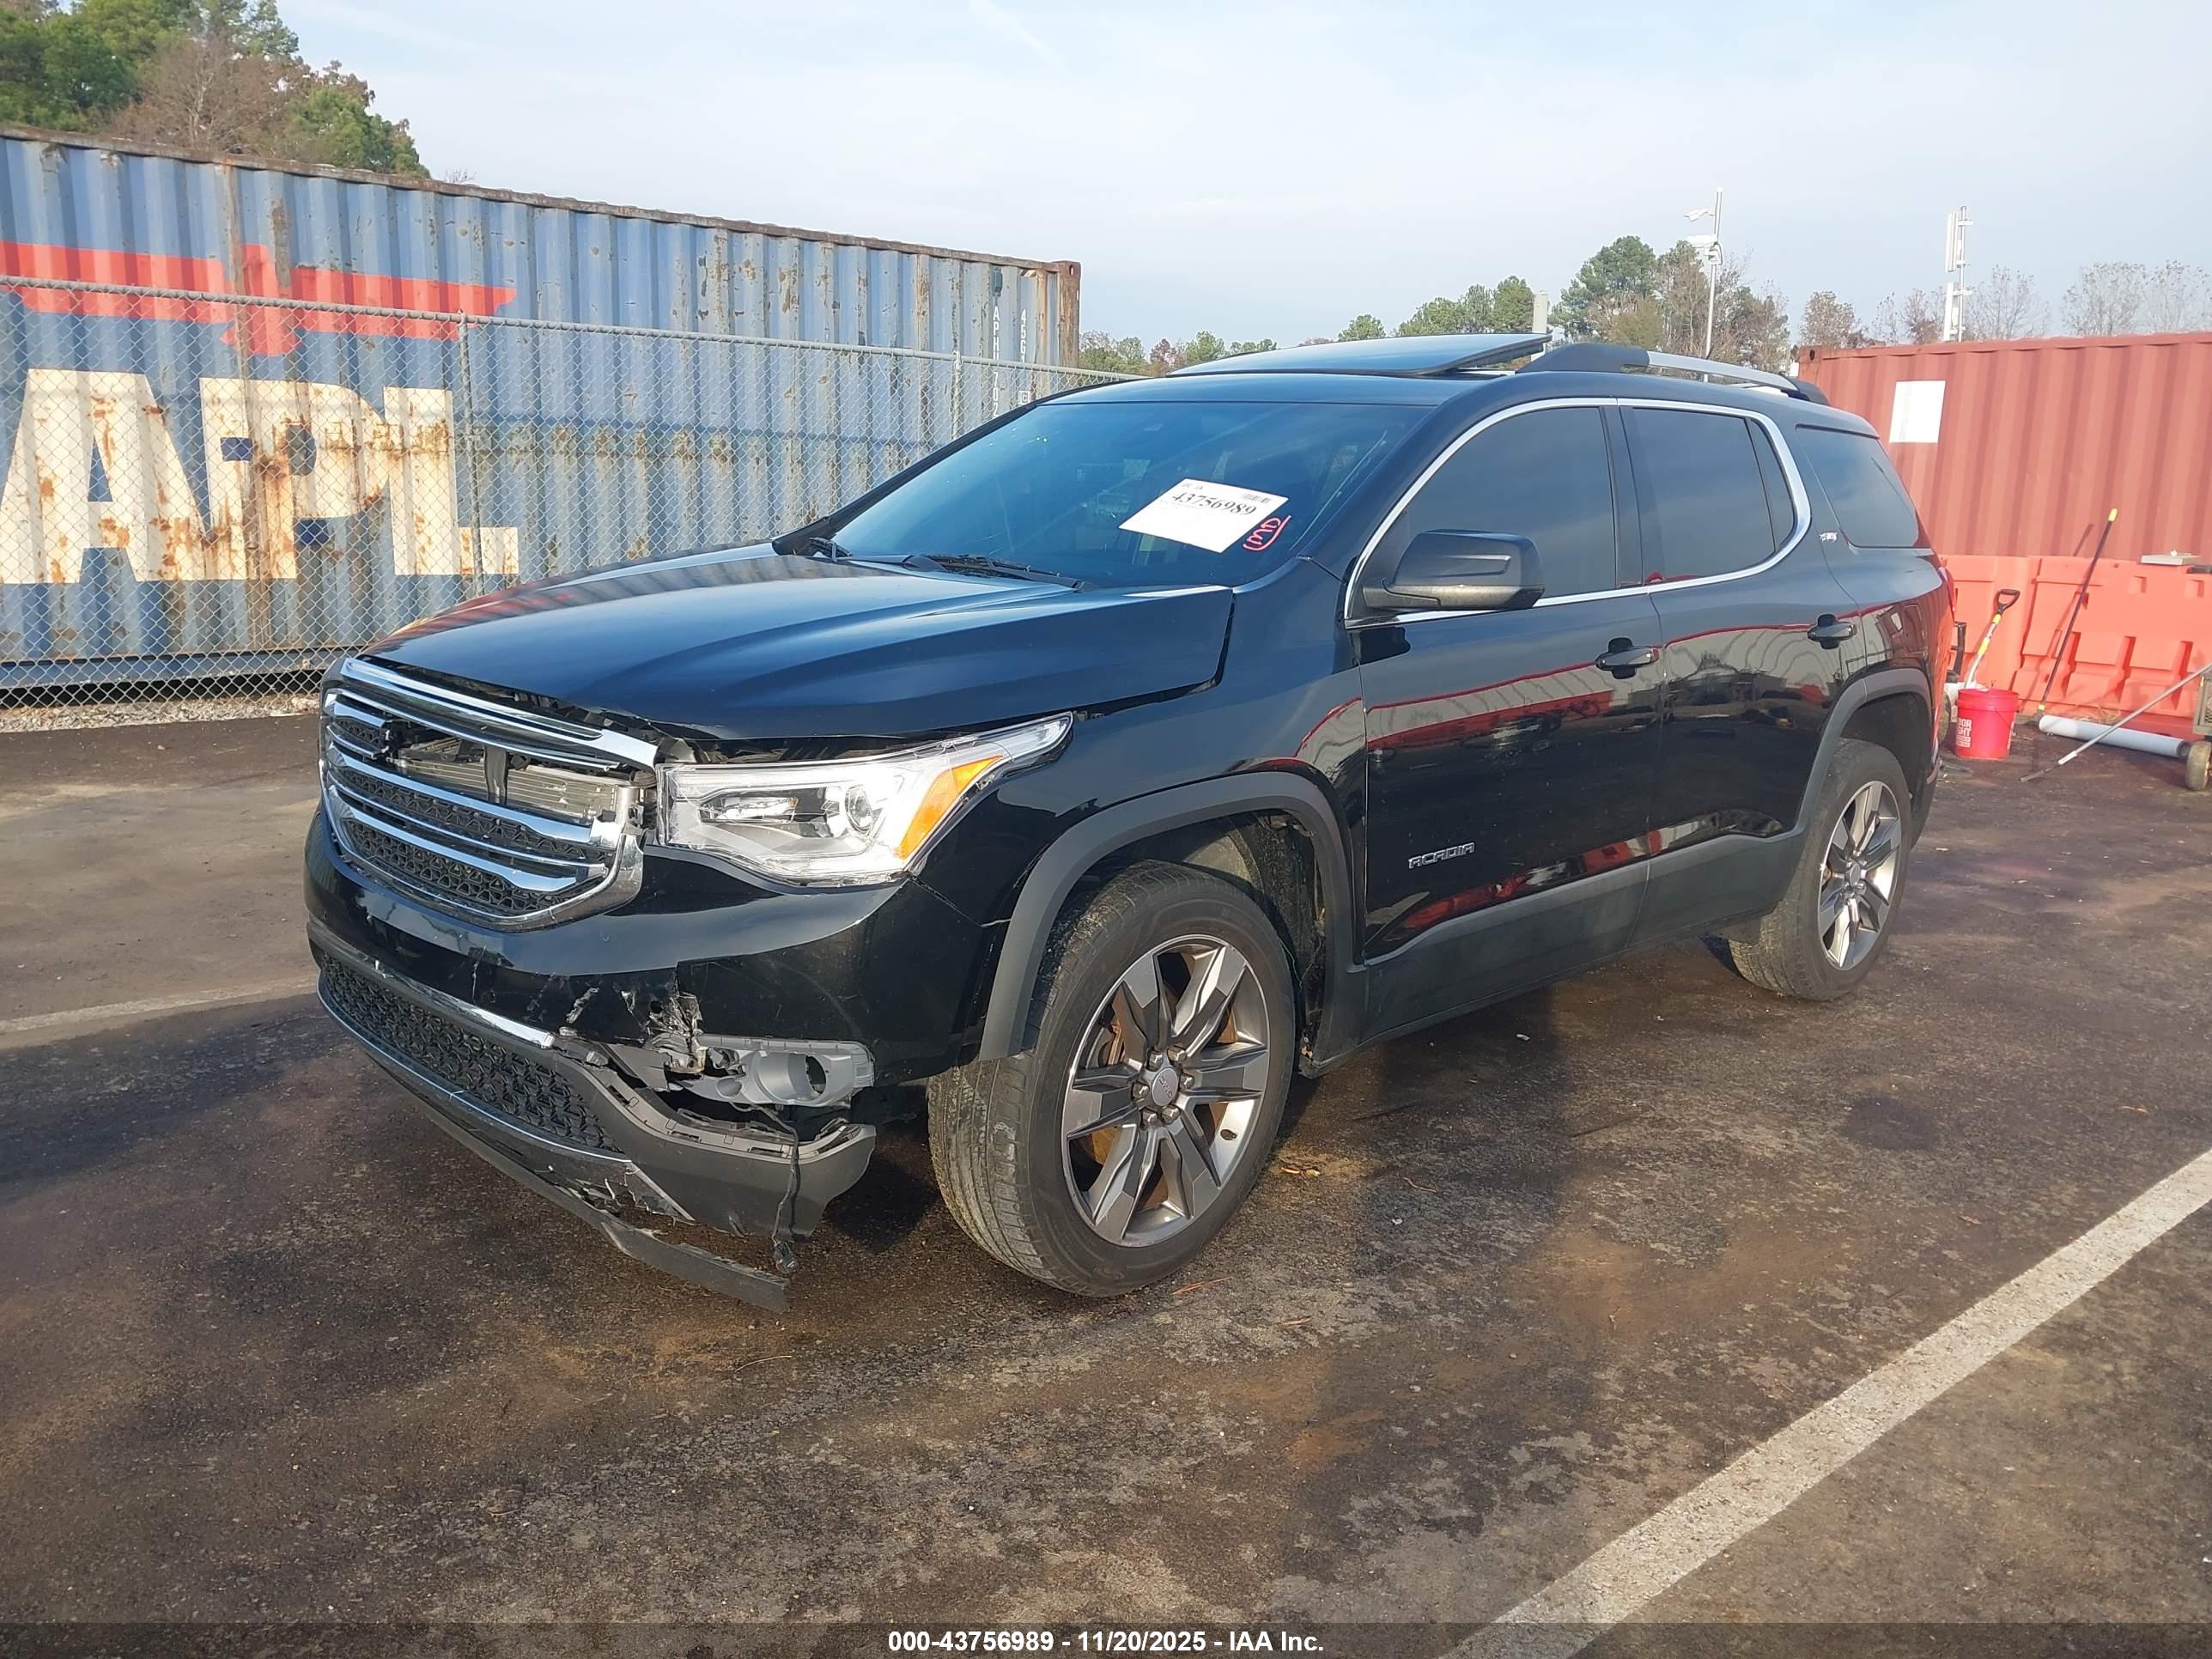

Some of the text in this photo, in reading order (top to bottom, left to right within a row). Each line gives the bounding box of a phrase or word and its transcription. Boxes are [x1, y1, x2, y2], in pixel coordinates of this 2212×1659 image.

[0, 368, 519, 584] APL
[1172, 492, 1256, 515] 43756989
[1408, 842, 1474, 869] ACADIA
